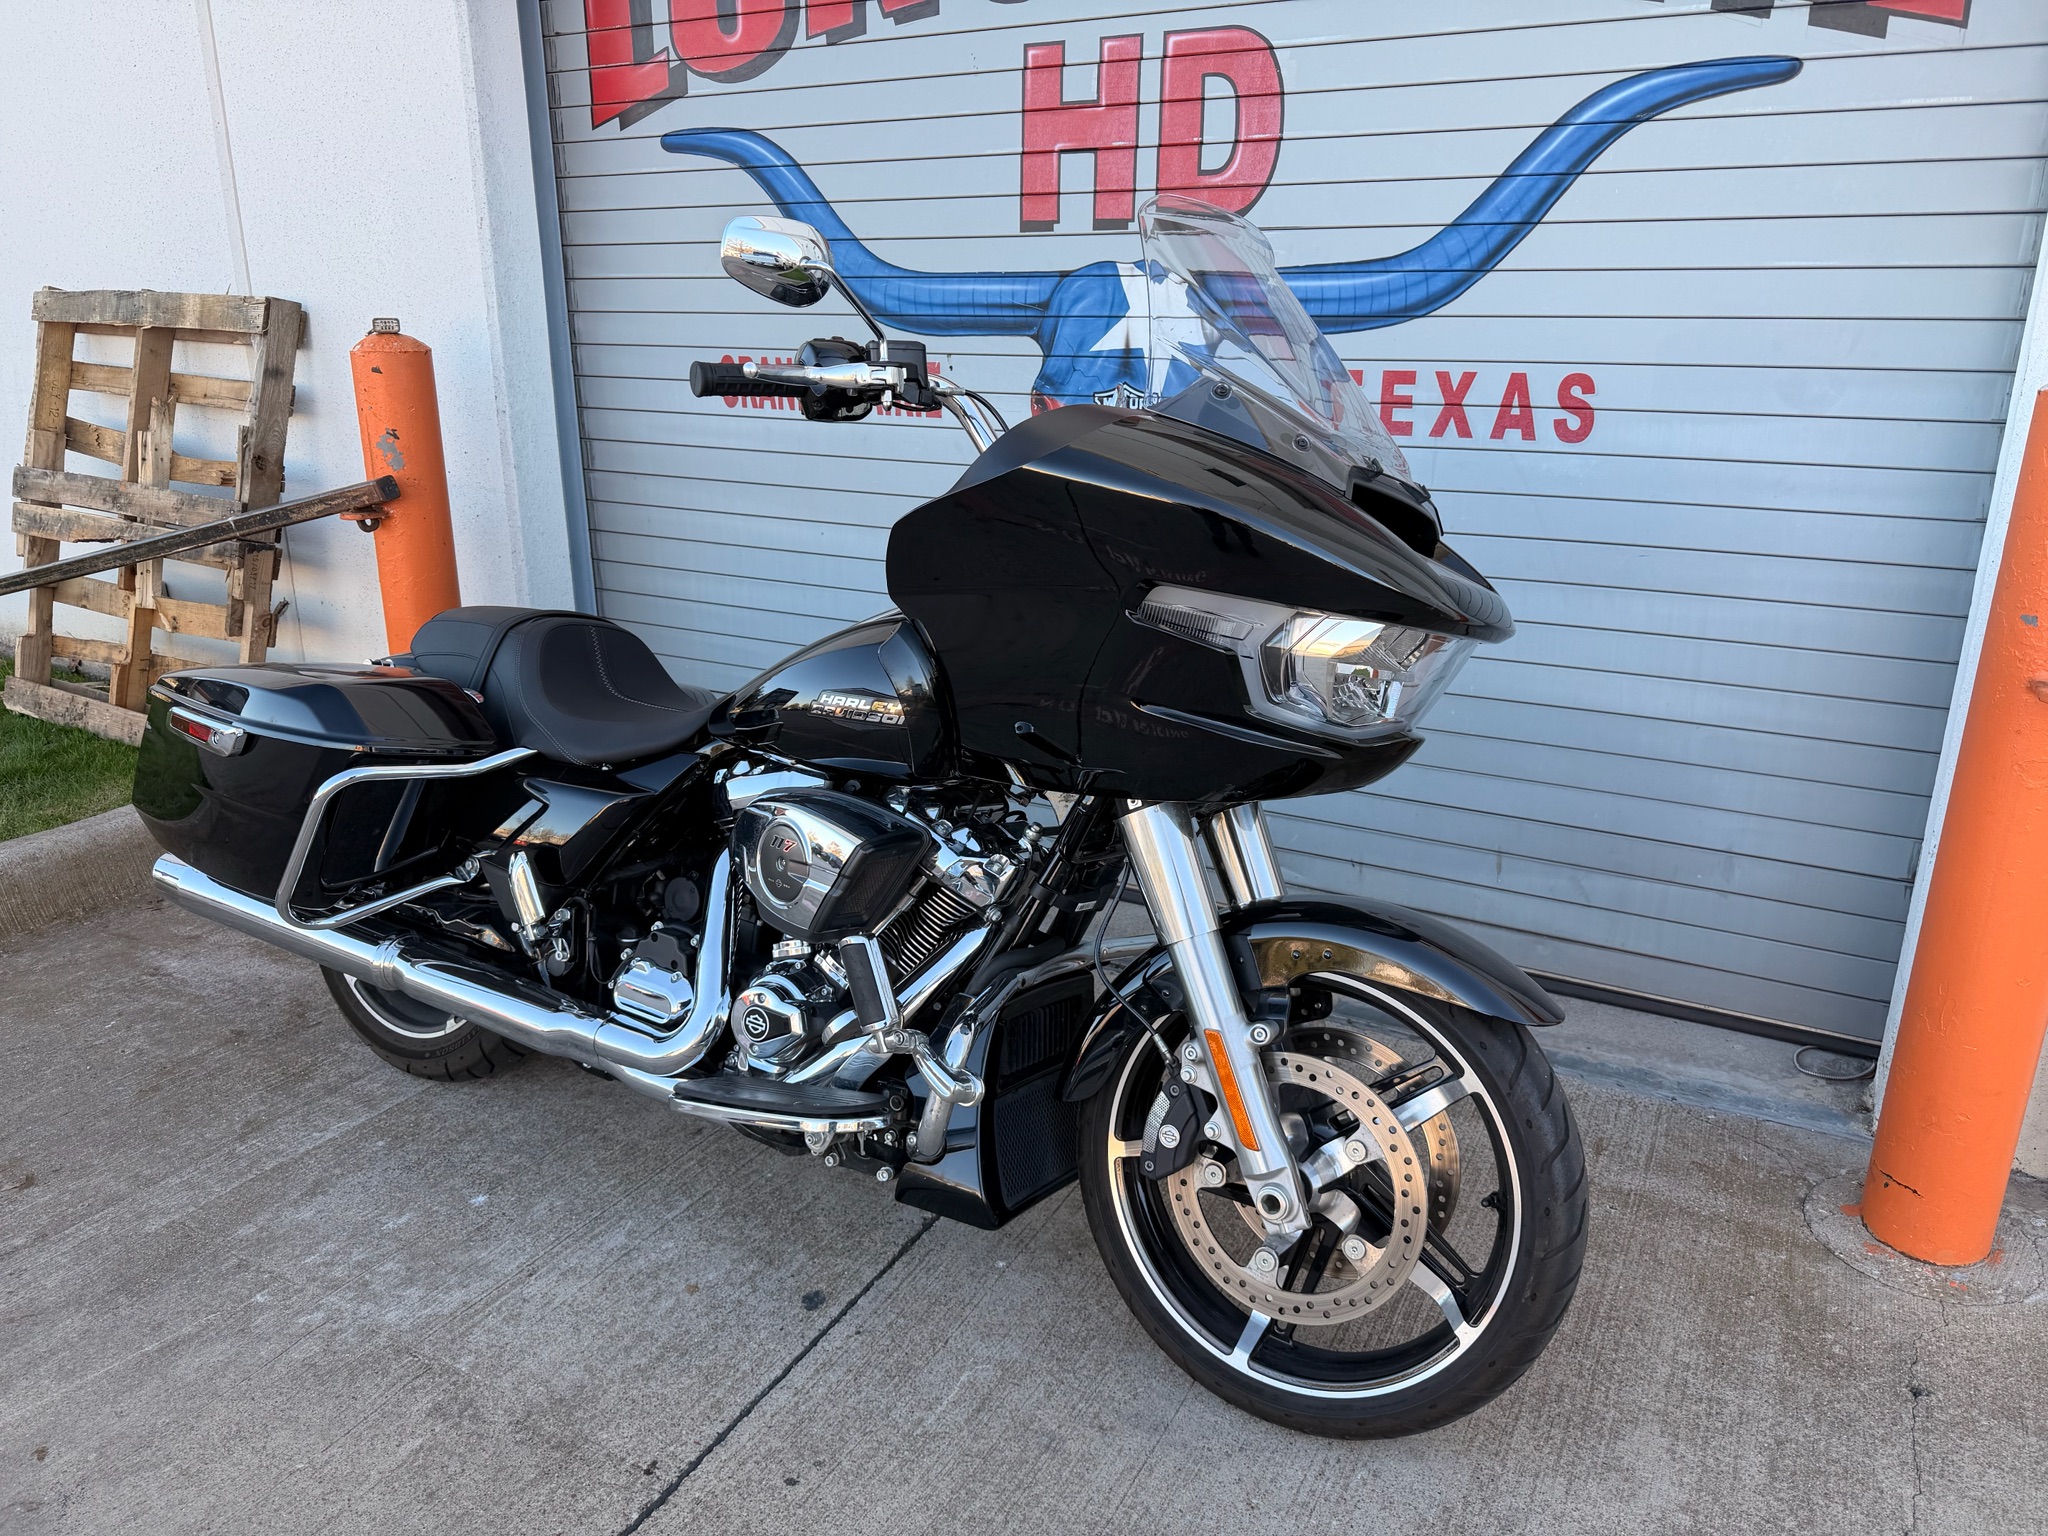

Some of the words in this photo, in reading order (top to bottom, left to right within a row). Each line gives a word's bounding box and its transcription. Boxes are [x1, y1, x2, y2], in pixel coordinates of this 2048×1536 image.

[1020, 25, 1284, 232] HD
[1348, 369, 1596, 443] EXAS
[820, 694, 903, 712] HARLEY
[770, 834, 798, 852] 117
